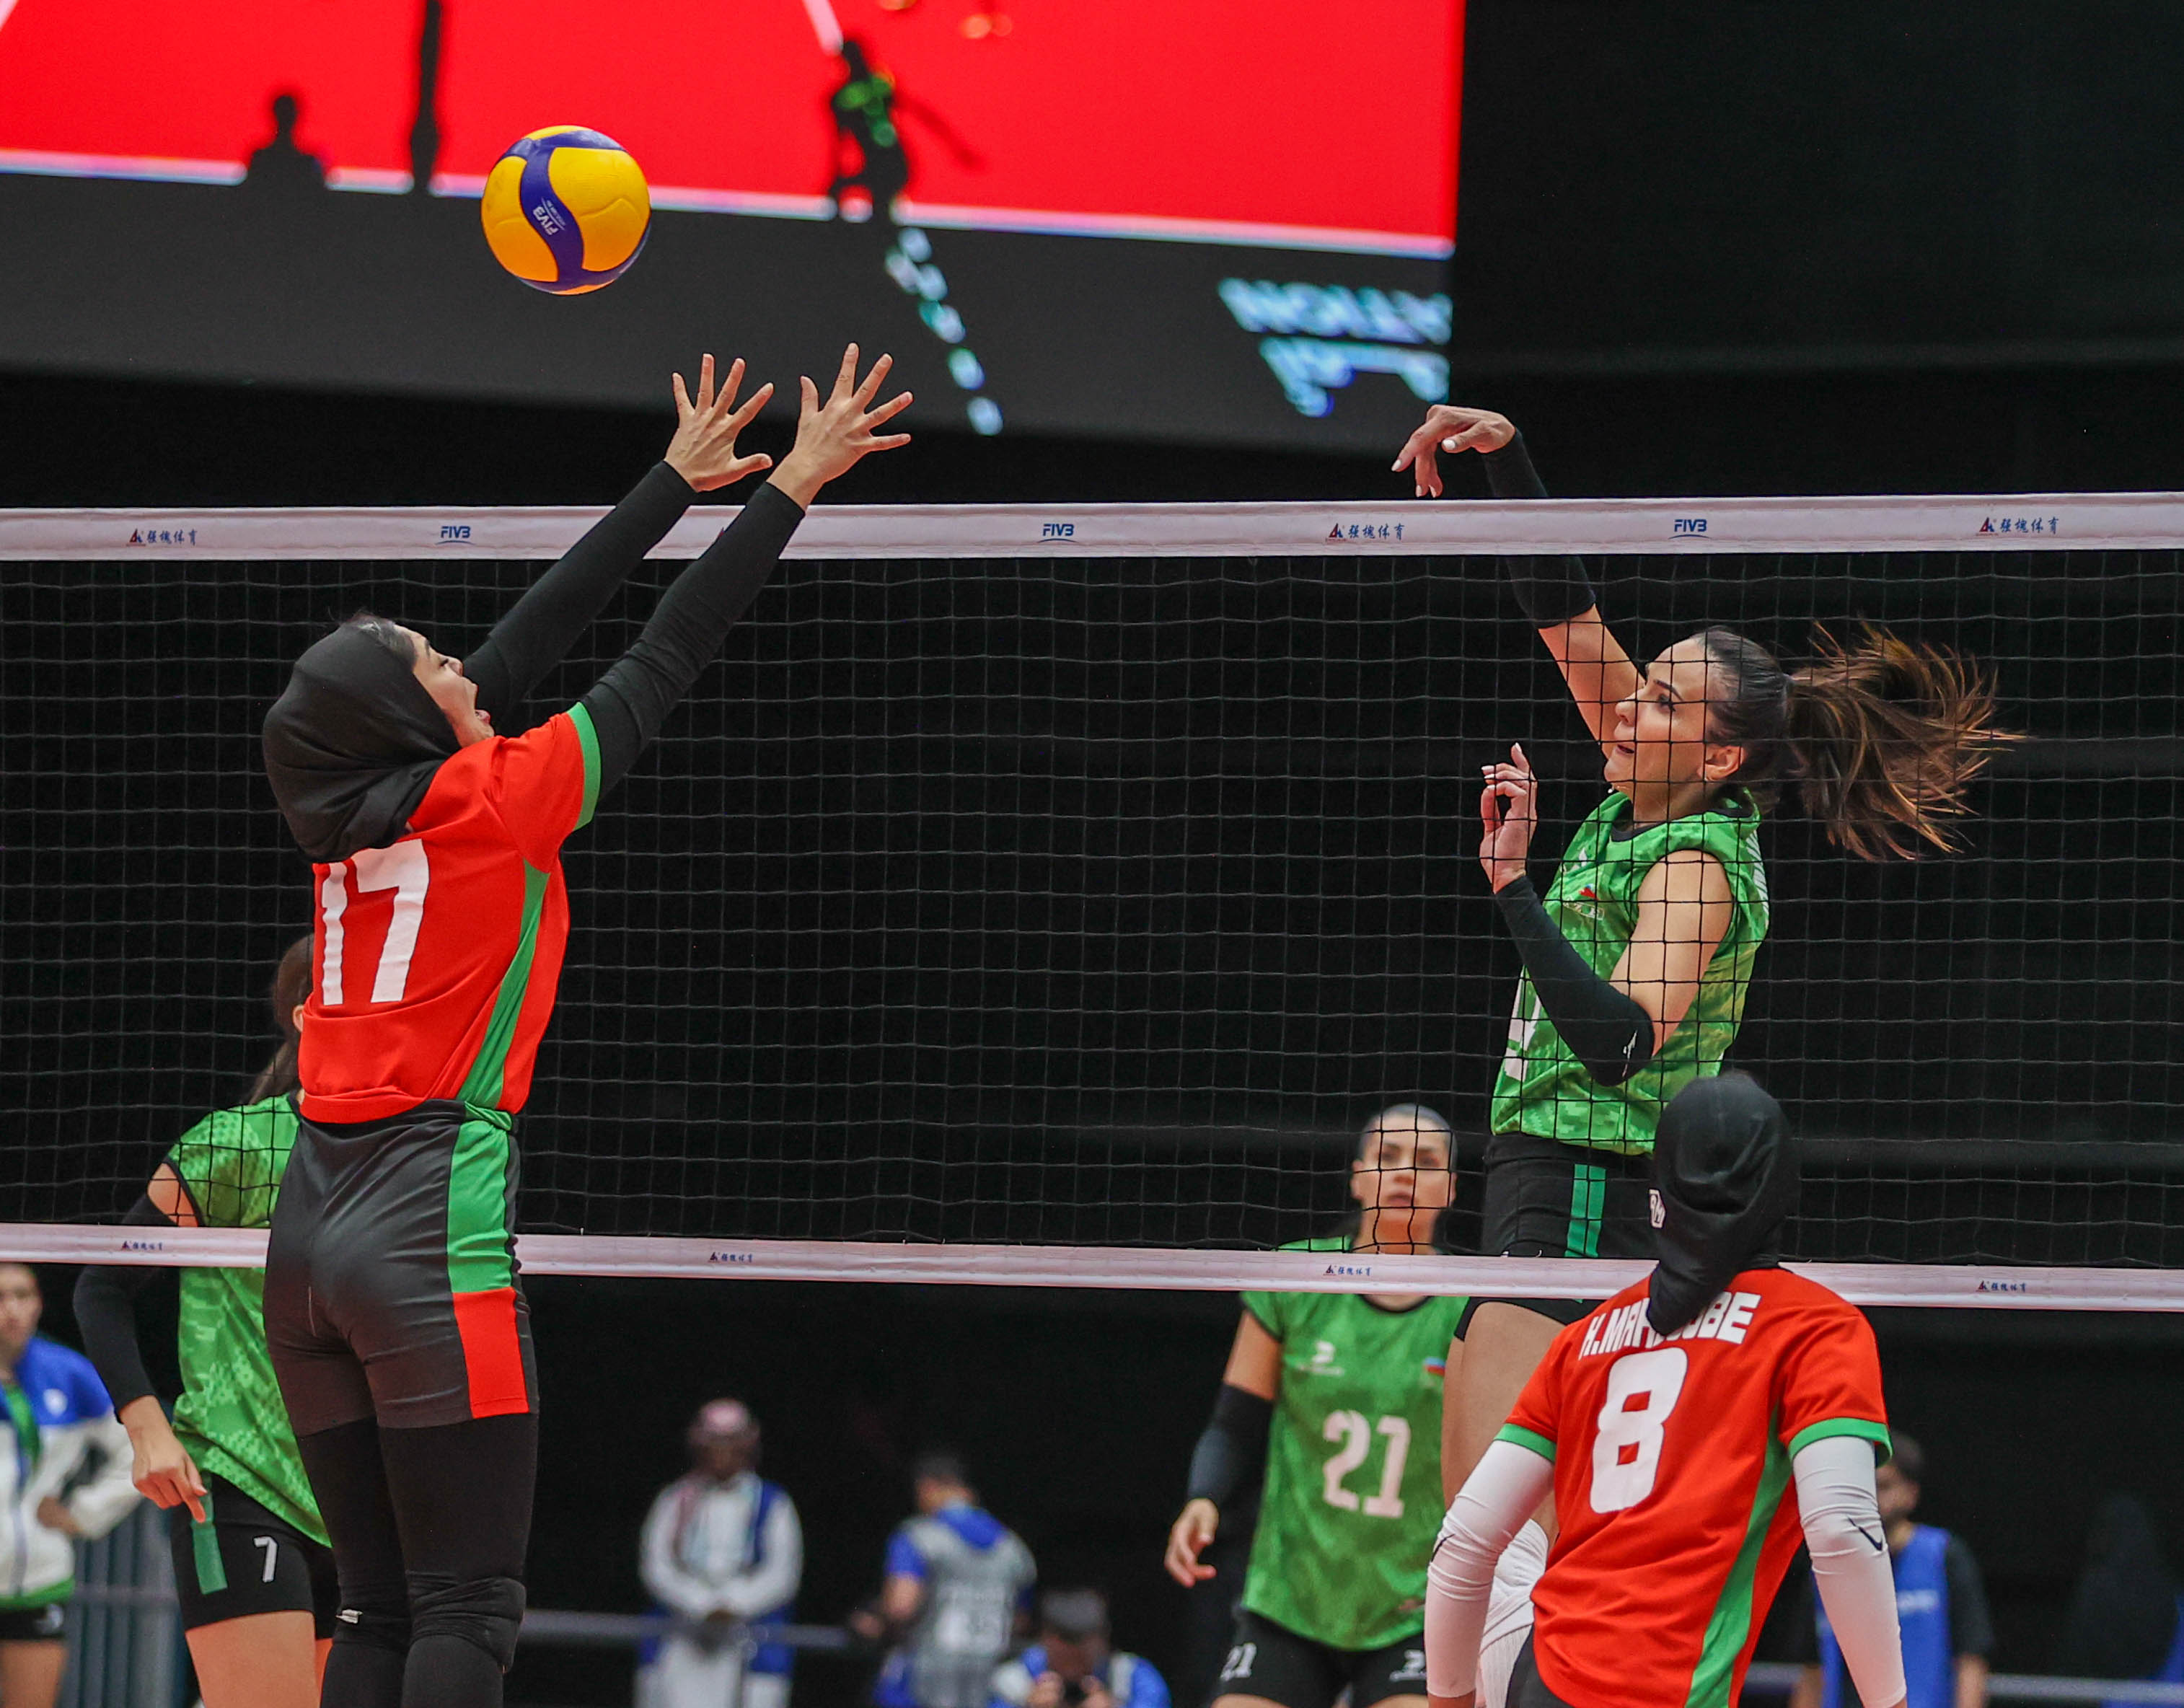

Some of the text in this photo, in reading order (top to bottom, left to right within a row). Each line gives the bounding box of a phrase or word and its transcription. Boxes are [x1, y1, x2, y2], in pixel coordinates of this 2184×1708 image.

[533, 206, 559, 235] FIVB
[441, 526, 471, 538] FIVB
[1043, 524, 1074, 536] FIVB
[1674, 519, 1707, 532] FIVB
[322, 837, 430, 1006] 17
[1589, 1346, 1688, 1514] 8
[1323, 1409, 1411, 1519] 21
[254, 1536, 278, 1582] 7
